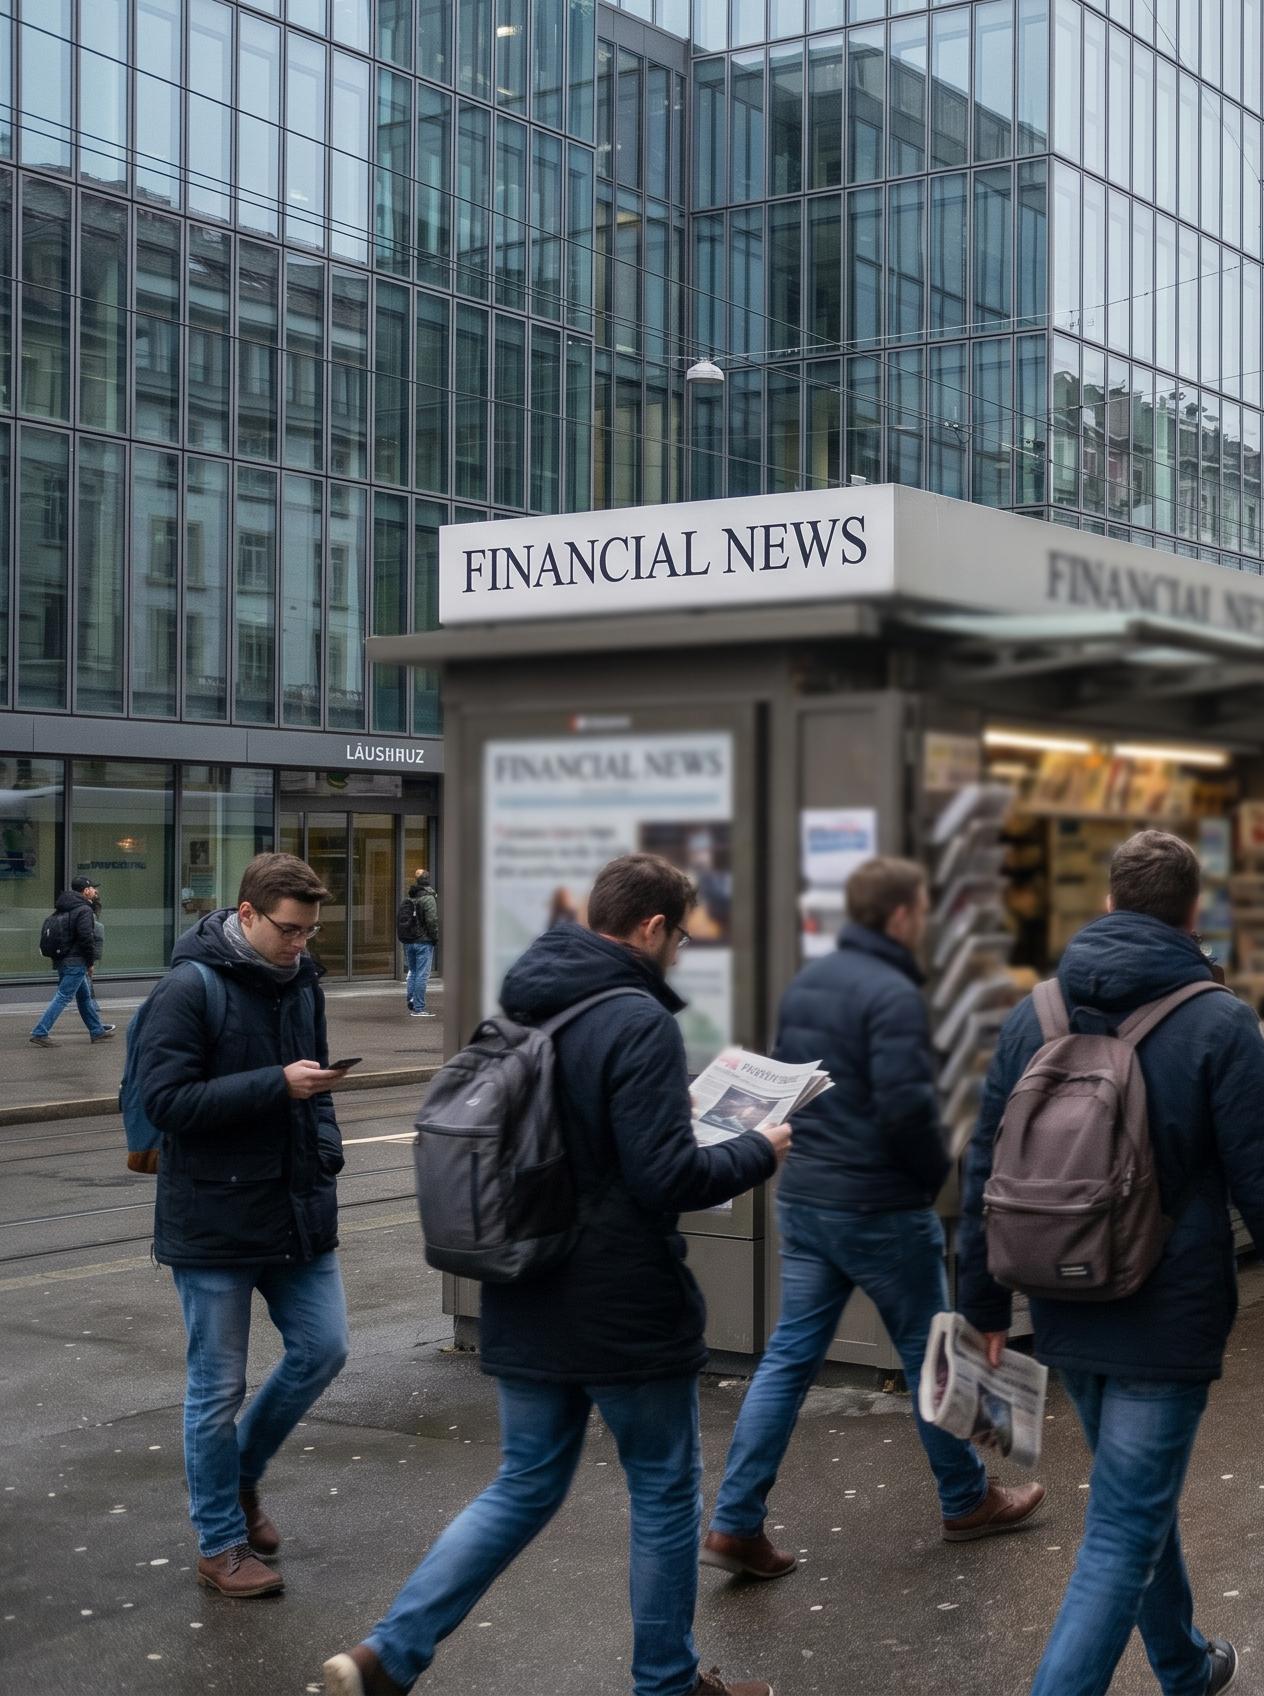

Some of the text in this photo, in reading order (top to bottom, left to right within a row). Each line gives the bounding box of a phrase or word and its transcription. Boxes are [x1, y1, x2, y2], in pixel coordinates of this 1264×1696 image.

[462, 515, 867, 593] FINANCIAL NEWS
[1046, 549, 1212, 622] FINANCIAL
[494, 748, 724, 784] FINANCIAL NEWS
